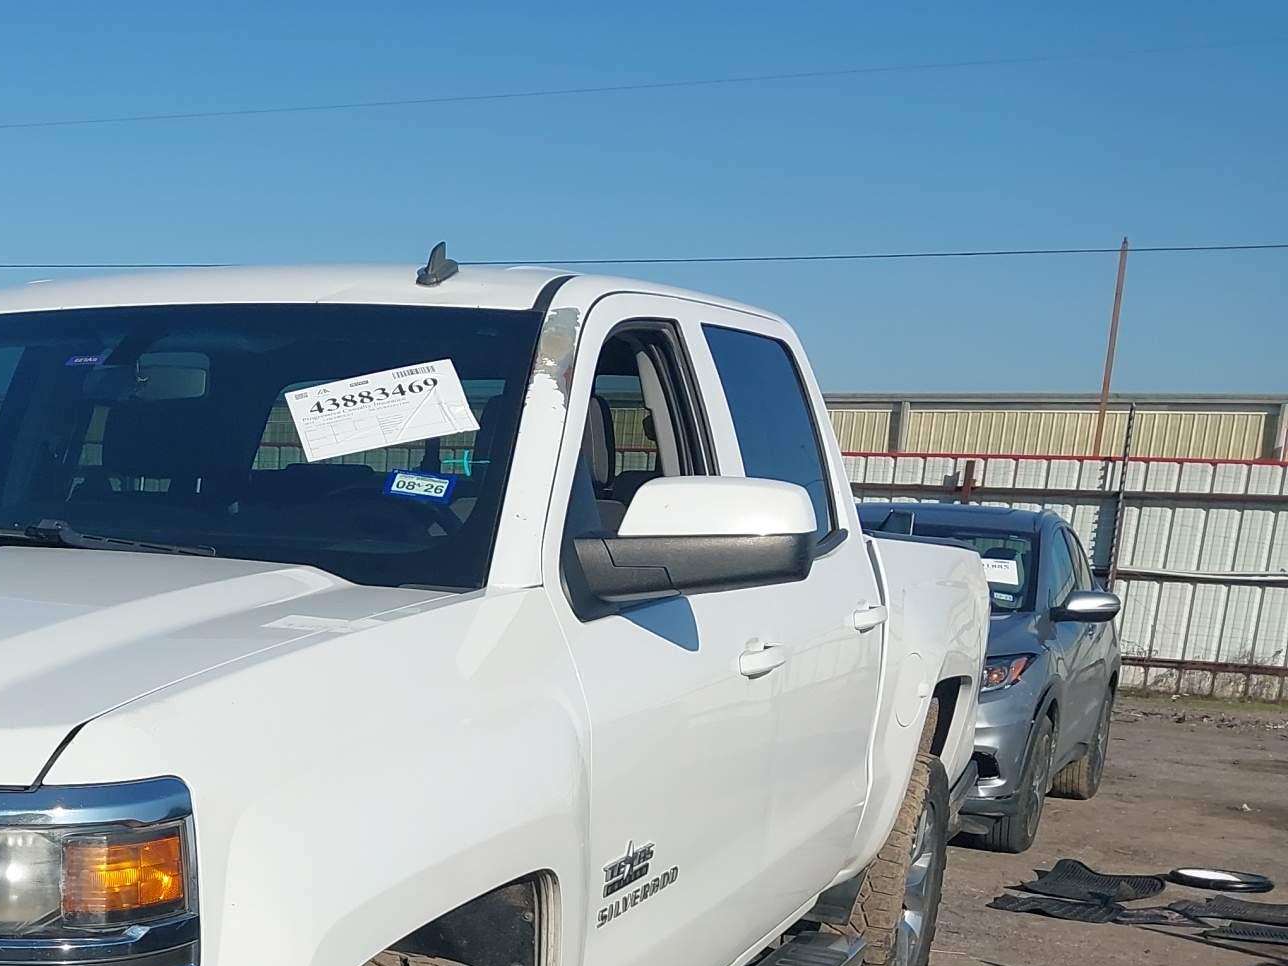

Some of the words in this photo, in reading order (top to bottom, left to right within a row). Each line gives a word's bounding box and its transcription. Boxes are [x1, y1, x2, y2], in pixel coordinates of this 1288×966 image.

[309, 377, 439, 414] 43883469
[395, 479, 416, 491] 08
[423, 483, 445, 495] 26
[596, 865, 679, 929] SILVERADO
